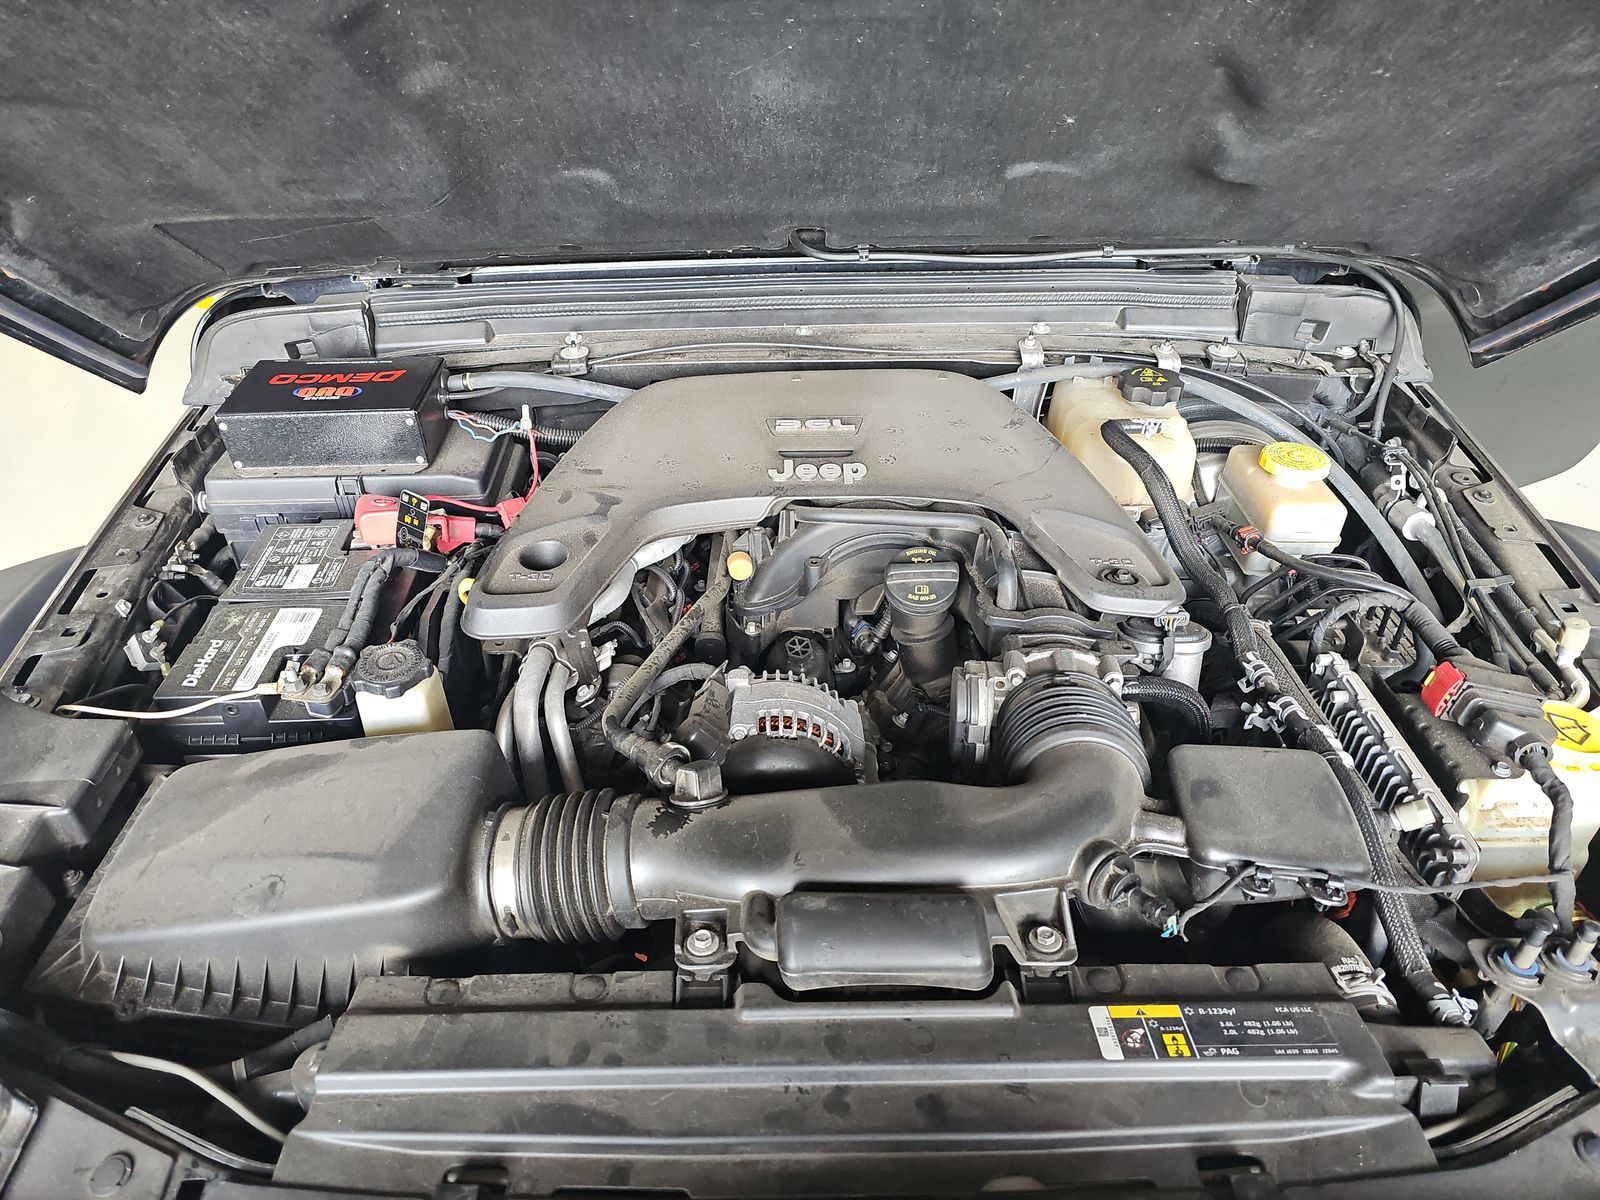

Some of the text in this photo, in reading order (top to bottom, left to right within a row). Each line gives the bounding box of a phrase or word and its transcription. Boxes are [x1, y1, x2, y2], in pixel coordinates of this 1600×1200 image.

[268, 369, 408, 386] DEMCO
[297, 386, 355, 397] DUO
[774, 417, 856, 433] 3.6L
[767, 459, 868, 485] Jeep
[905, 548, 928, 557] ENGINE
[907, 593, 920, 601] SAE
[181, 639, 226, 687] DieHard
[1198, 1007, 1236, 1016] R-1234yf
